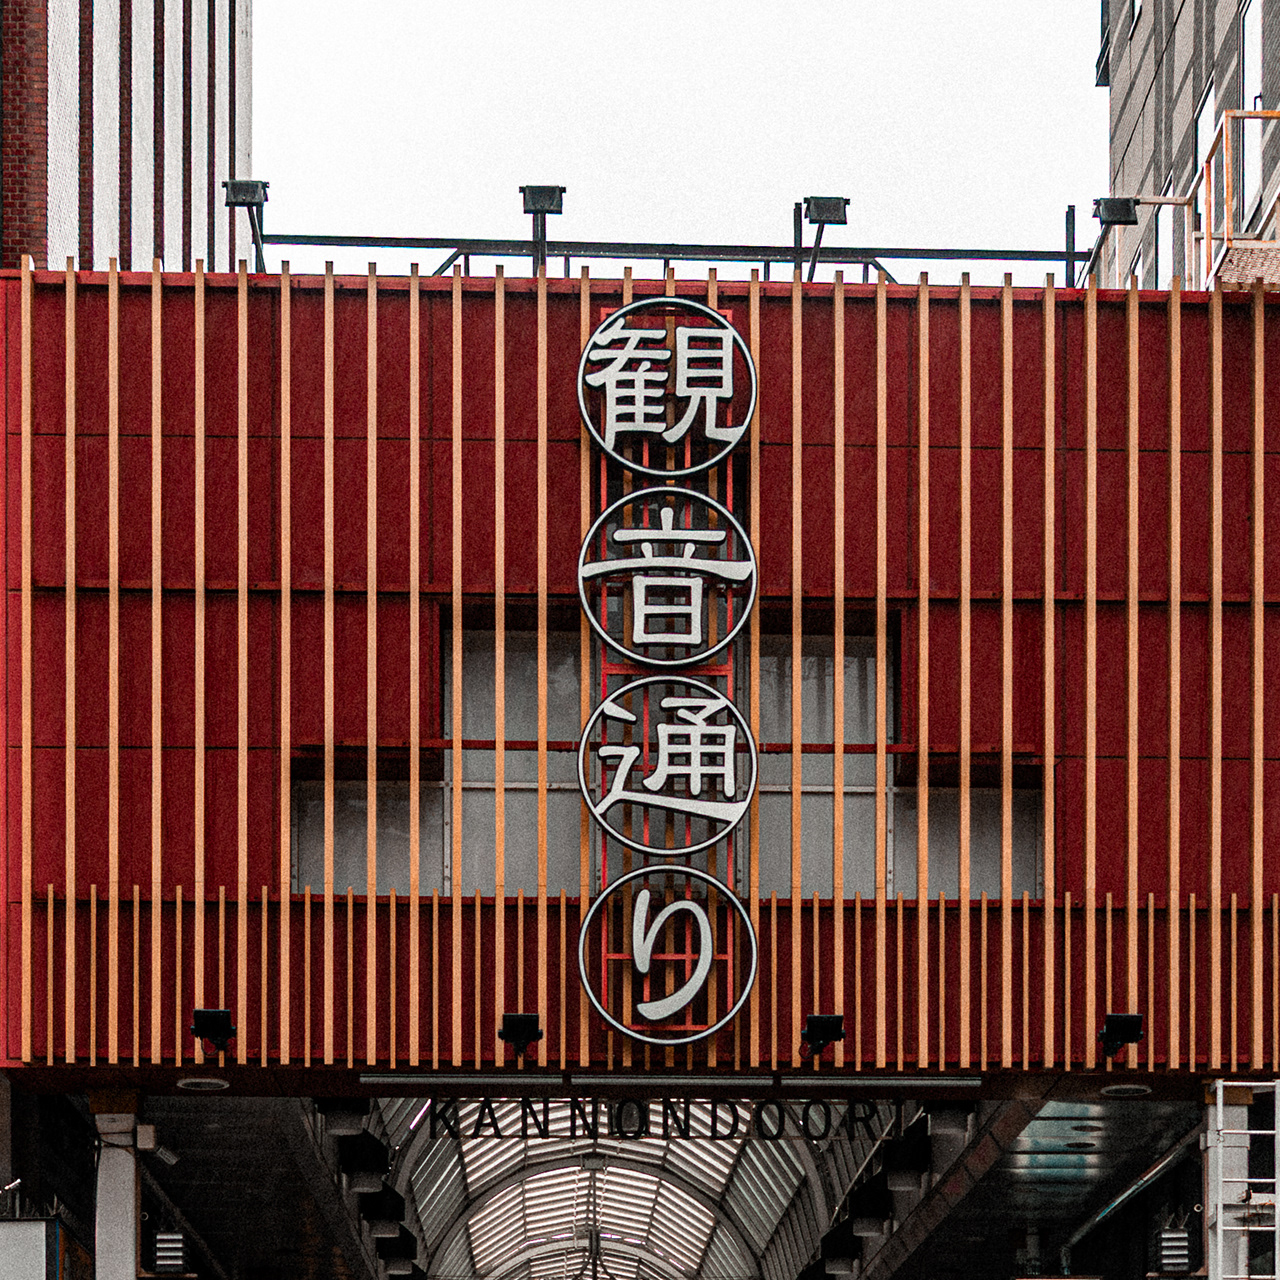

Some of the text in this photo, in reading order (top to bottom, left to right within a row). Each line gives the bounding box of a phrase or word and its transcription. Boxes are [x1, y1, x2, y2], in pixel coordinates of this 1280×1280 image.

[582, 316, 754, 1022] 観音通り
[428, 1098, 904, 1140] KANNONDOORI
